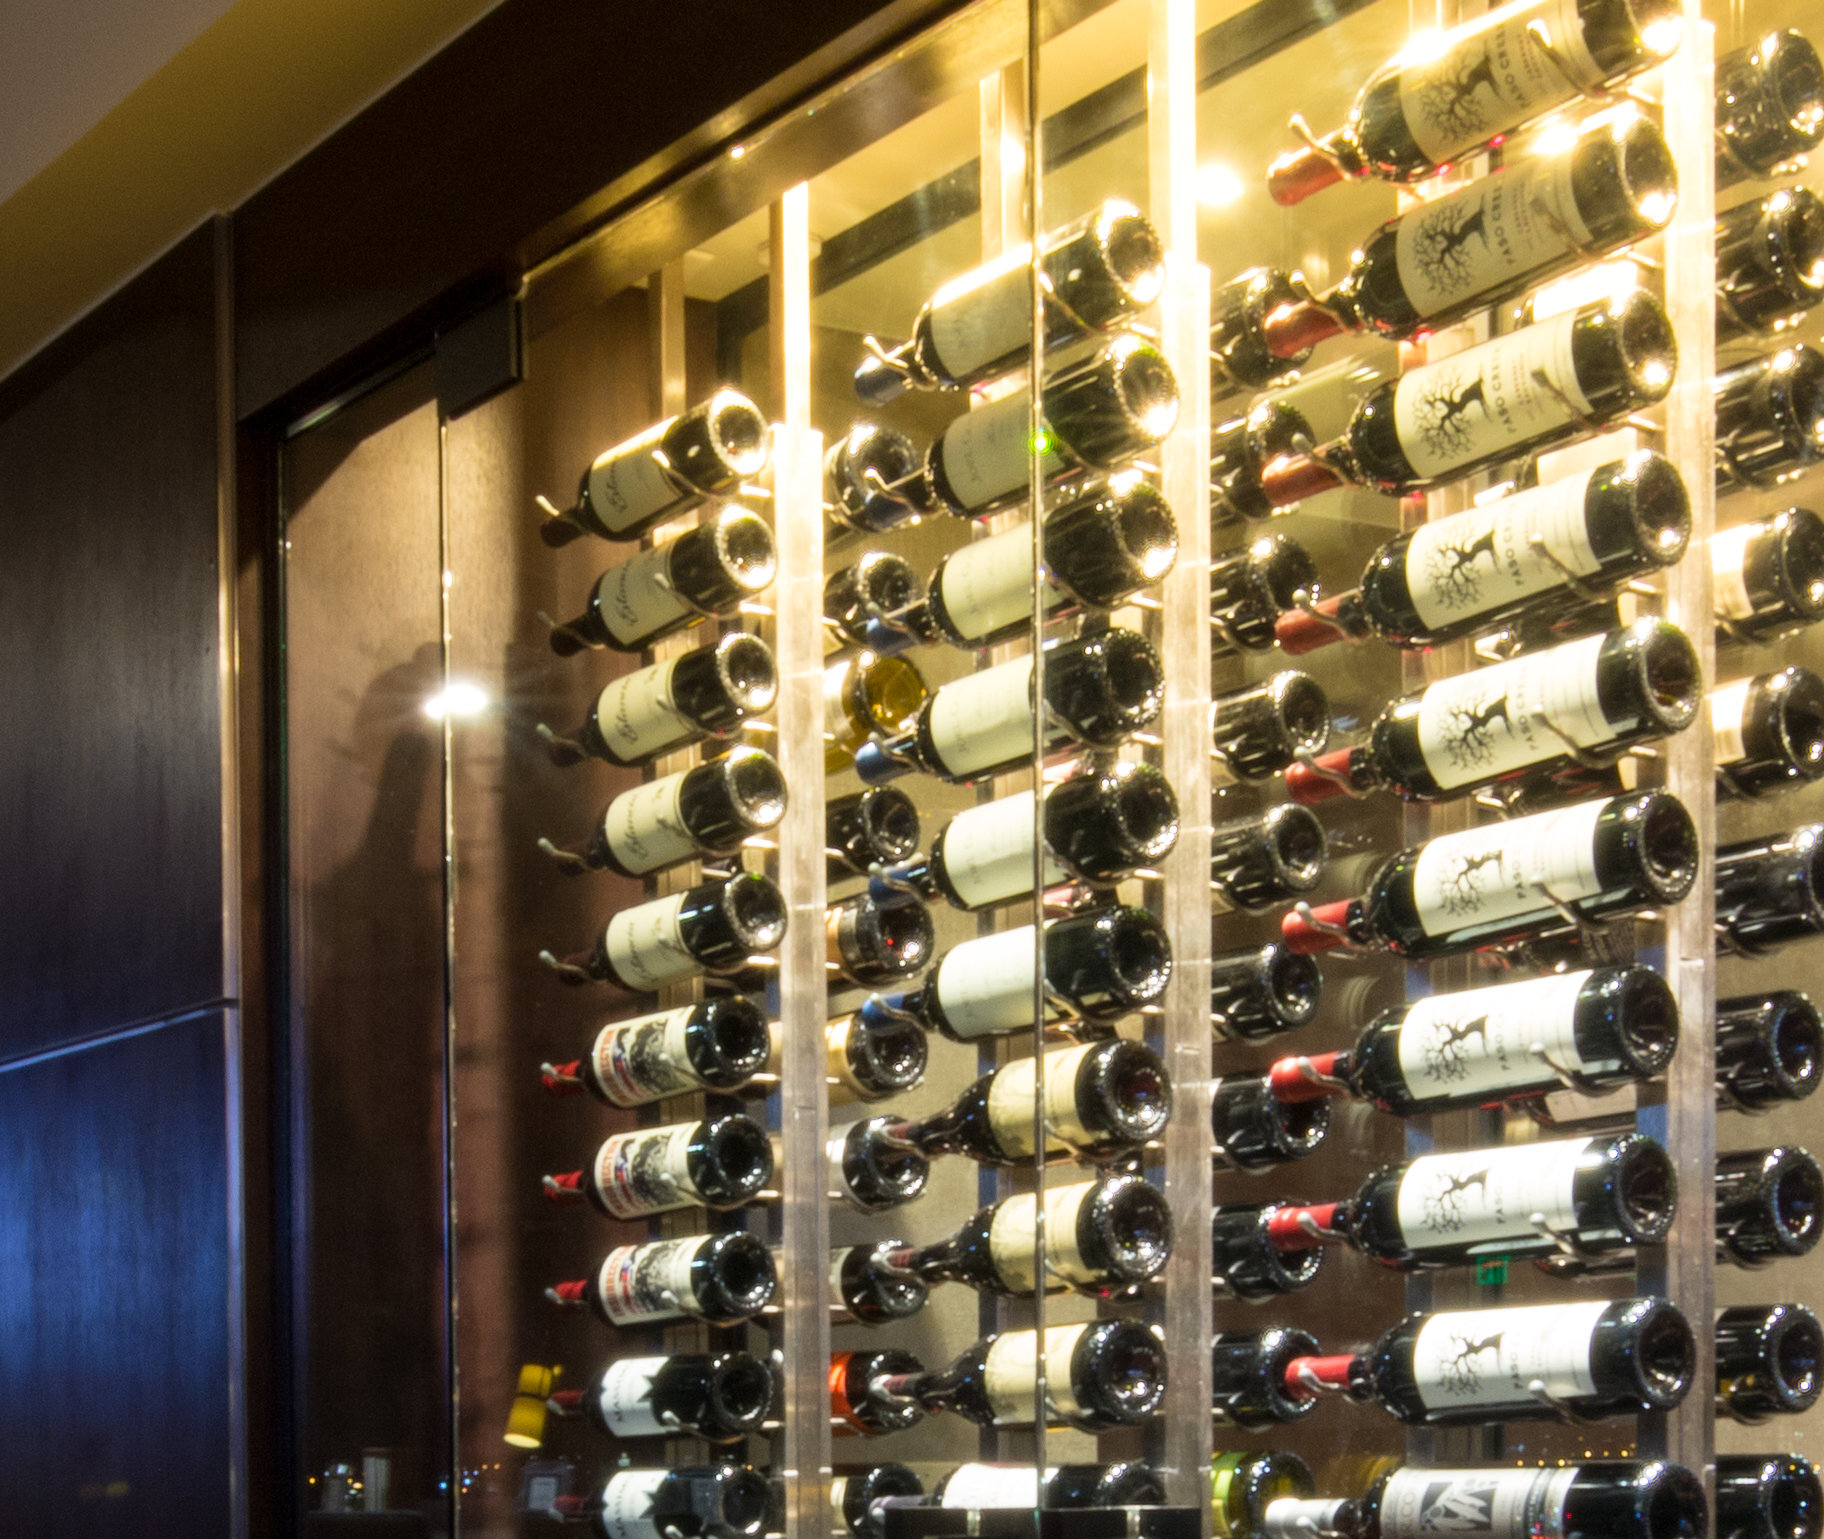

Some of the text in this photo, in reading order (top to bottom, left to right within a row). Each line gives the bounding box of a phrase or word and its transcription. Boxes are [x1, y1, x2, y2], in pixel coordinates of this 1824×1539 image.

[1494, 226, 1516, 265] PASO
[1495, 397, 1517, 433] PASO
[1505, 549, 1525, 586] PASO
[1518, 715, 1538, 750] PASO
[1512, 861, 1527, 900] PASO
[1495, 1033, 1510, 1071] PASO
[1509, 1352, 1523, 1389] PASO
